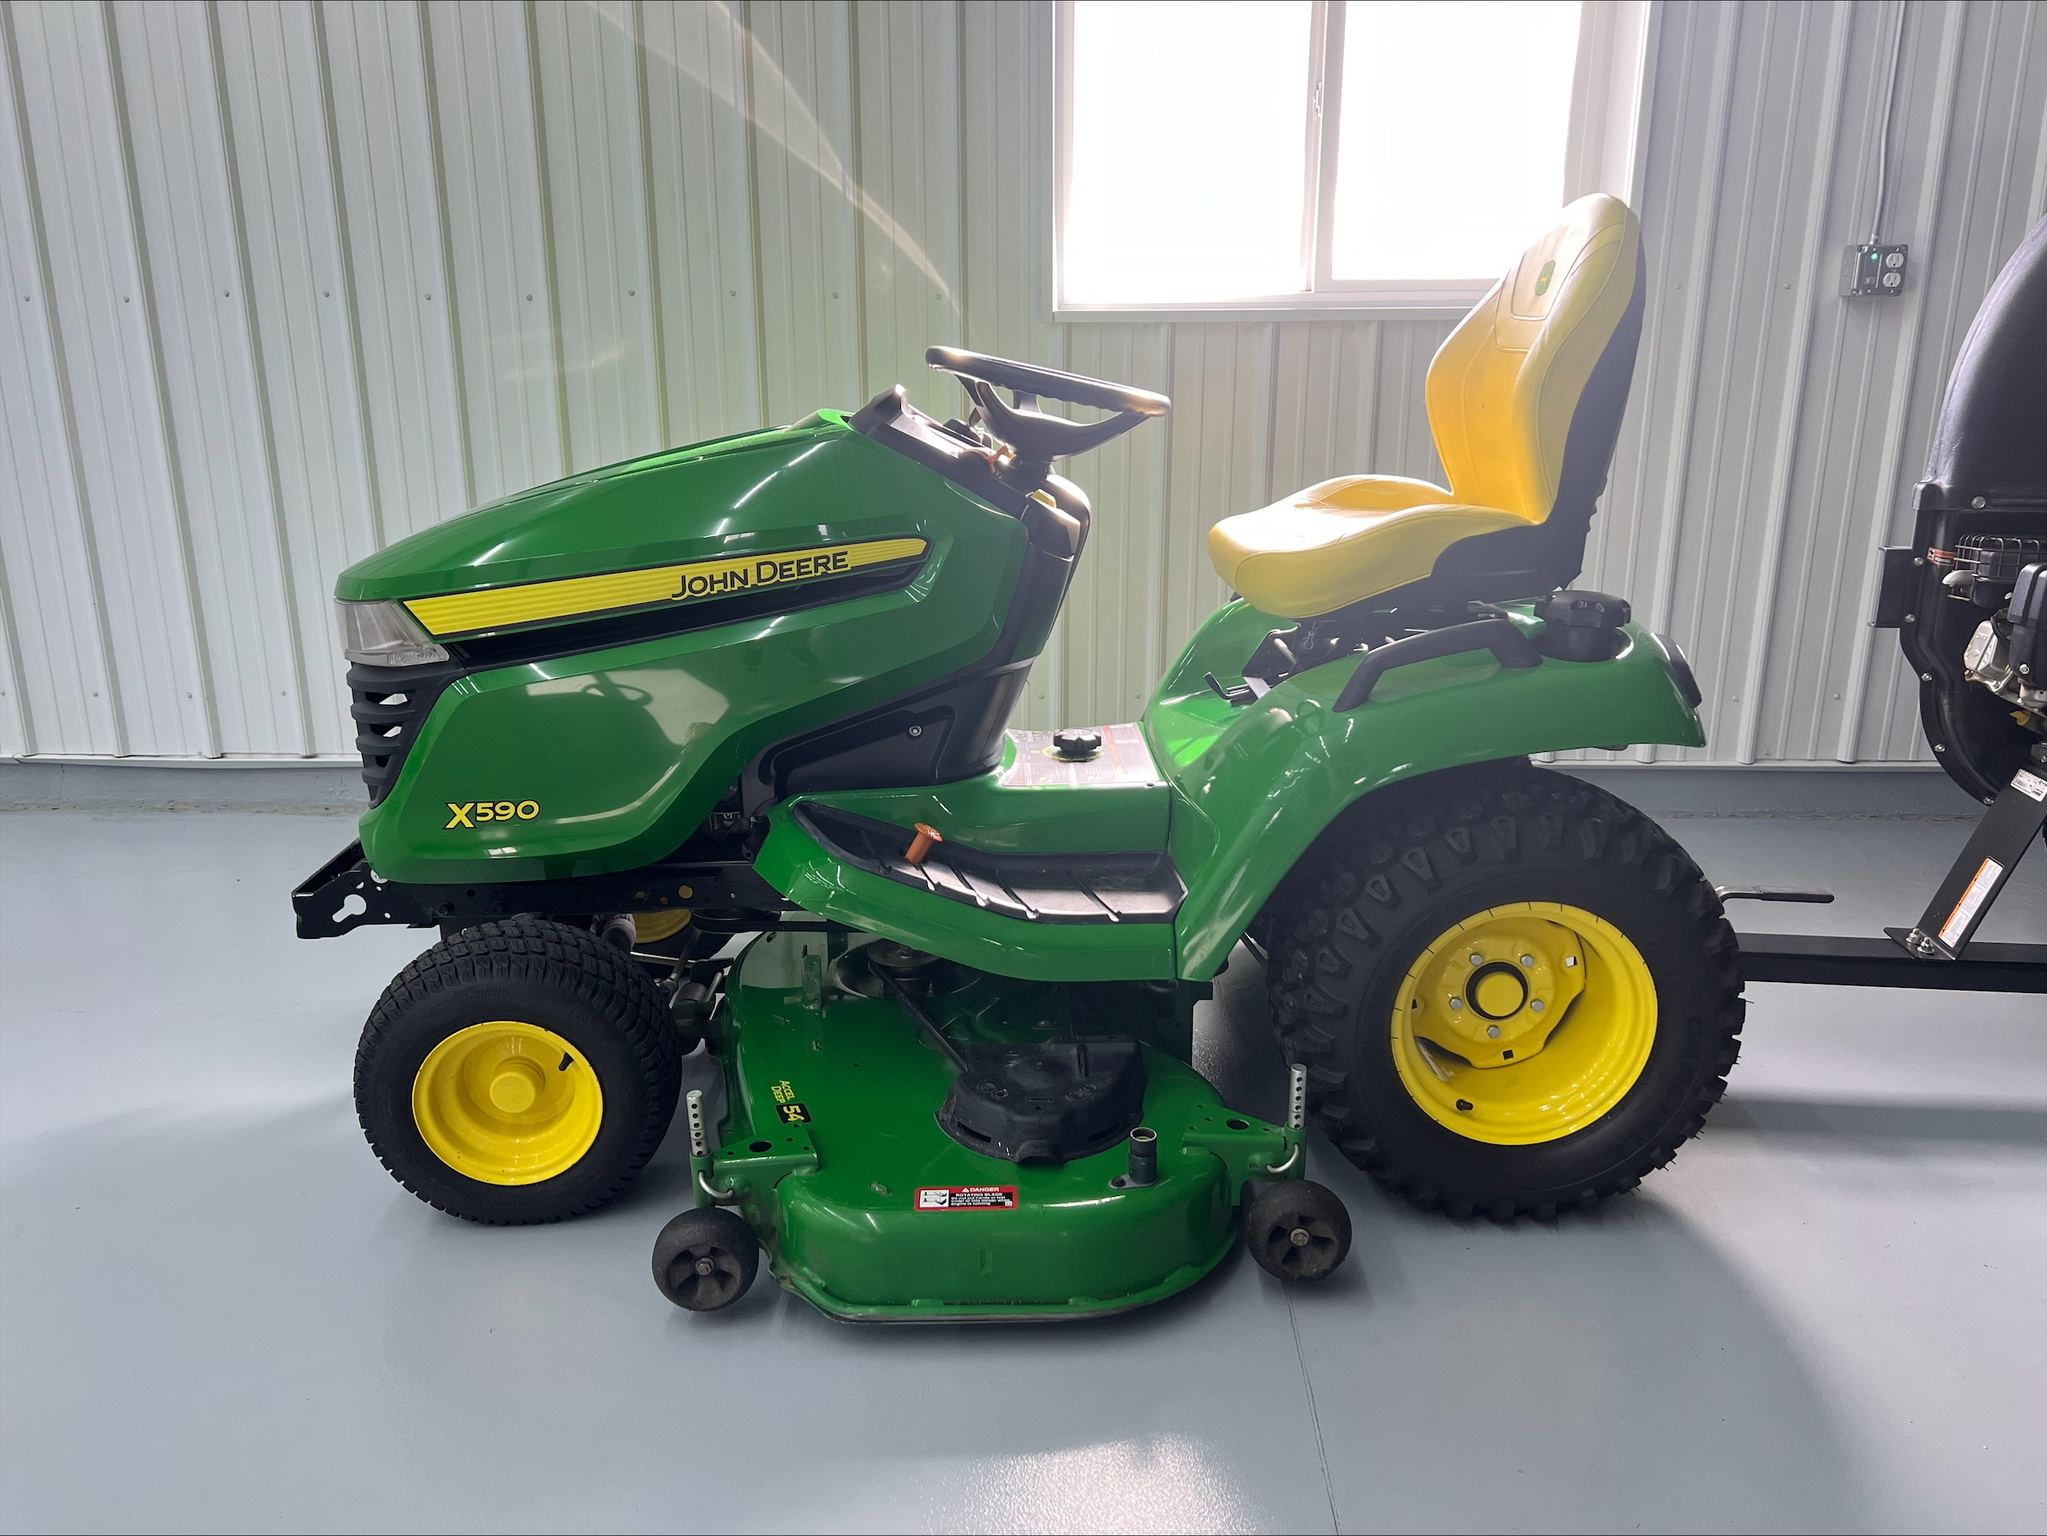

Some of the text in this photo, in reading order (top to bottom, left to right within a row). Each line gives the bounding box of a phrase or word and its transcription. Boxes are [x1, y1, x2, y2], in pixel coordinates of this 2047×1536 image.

[671, 551, 849, 599] JOHN DEERE
[442, 799, 541, 830] X590
[770, 1085, 786, 1104] DEEP
[779, 1080, 795, 1101] ACCEL
[783, 1105, 805, 1121] 54
